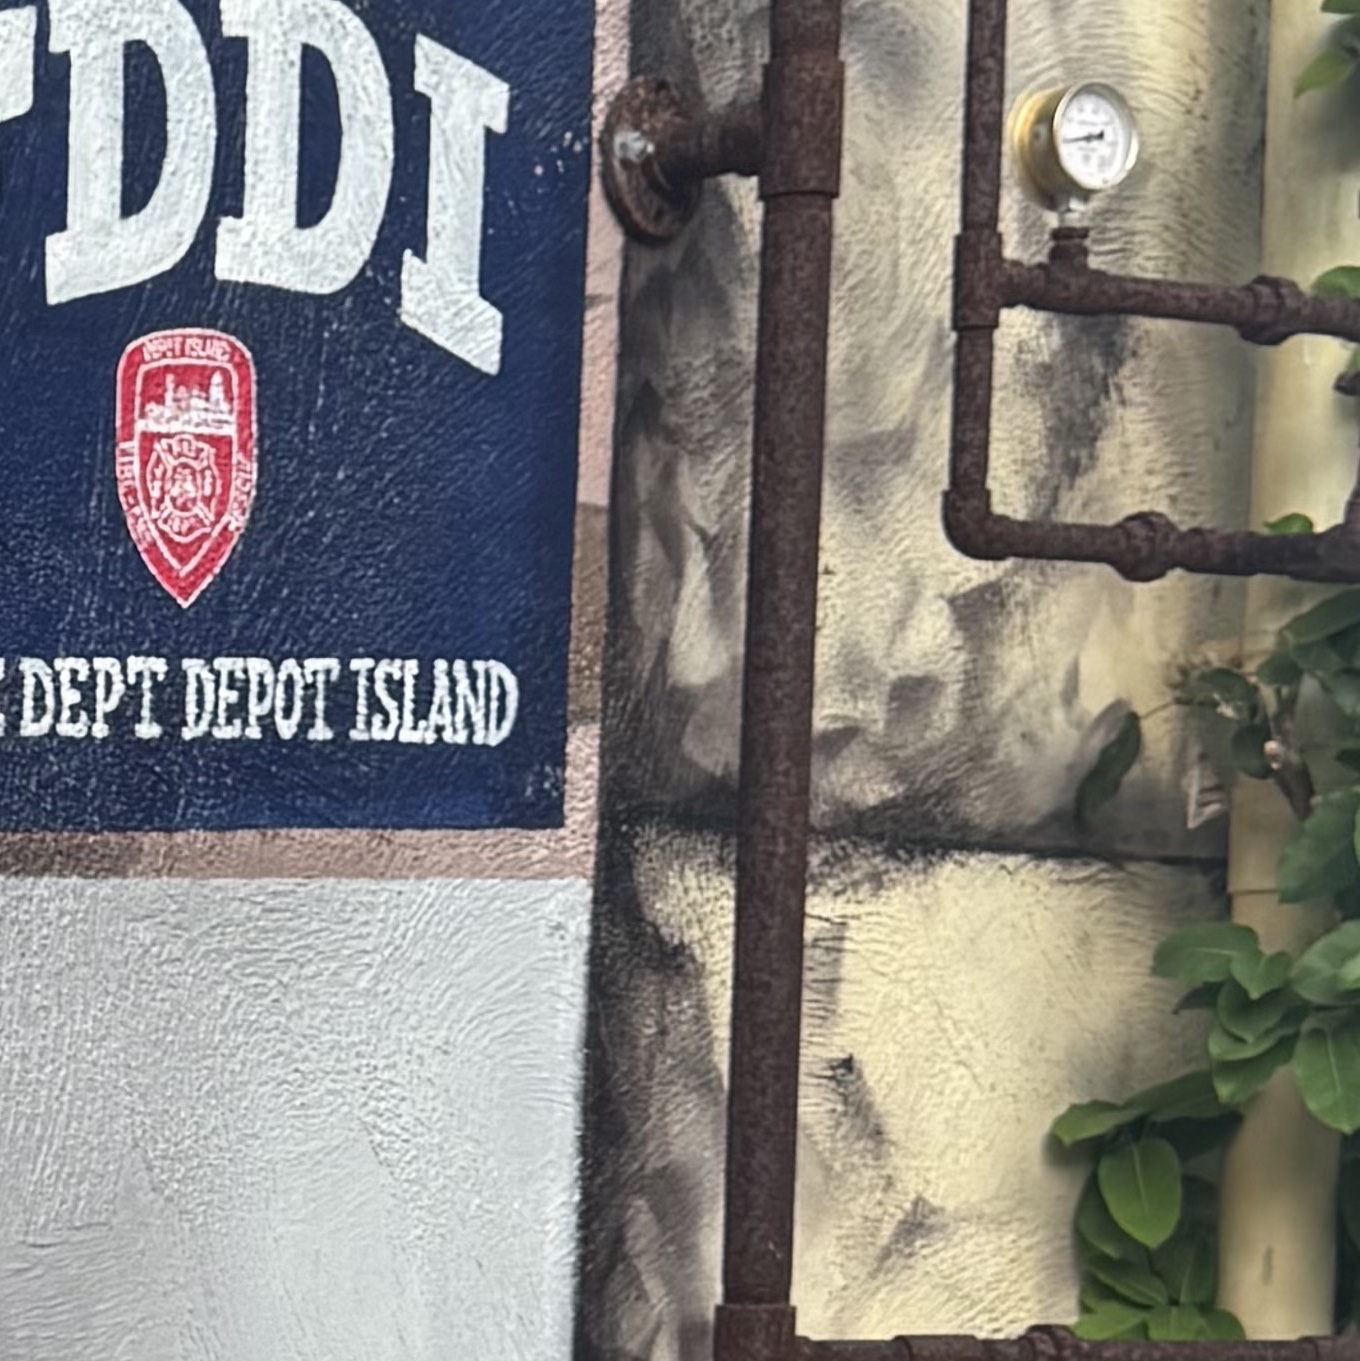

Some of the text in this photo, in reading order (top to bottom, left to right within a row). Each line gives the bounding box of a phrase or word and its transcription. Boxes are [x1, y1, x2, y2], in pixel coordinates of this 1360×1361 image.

[19, 655, 168, 738] DEPT
[180, 657, 340, 741] DEPOT
[348, 658, 520, 747] ISLAND
